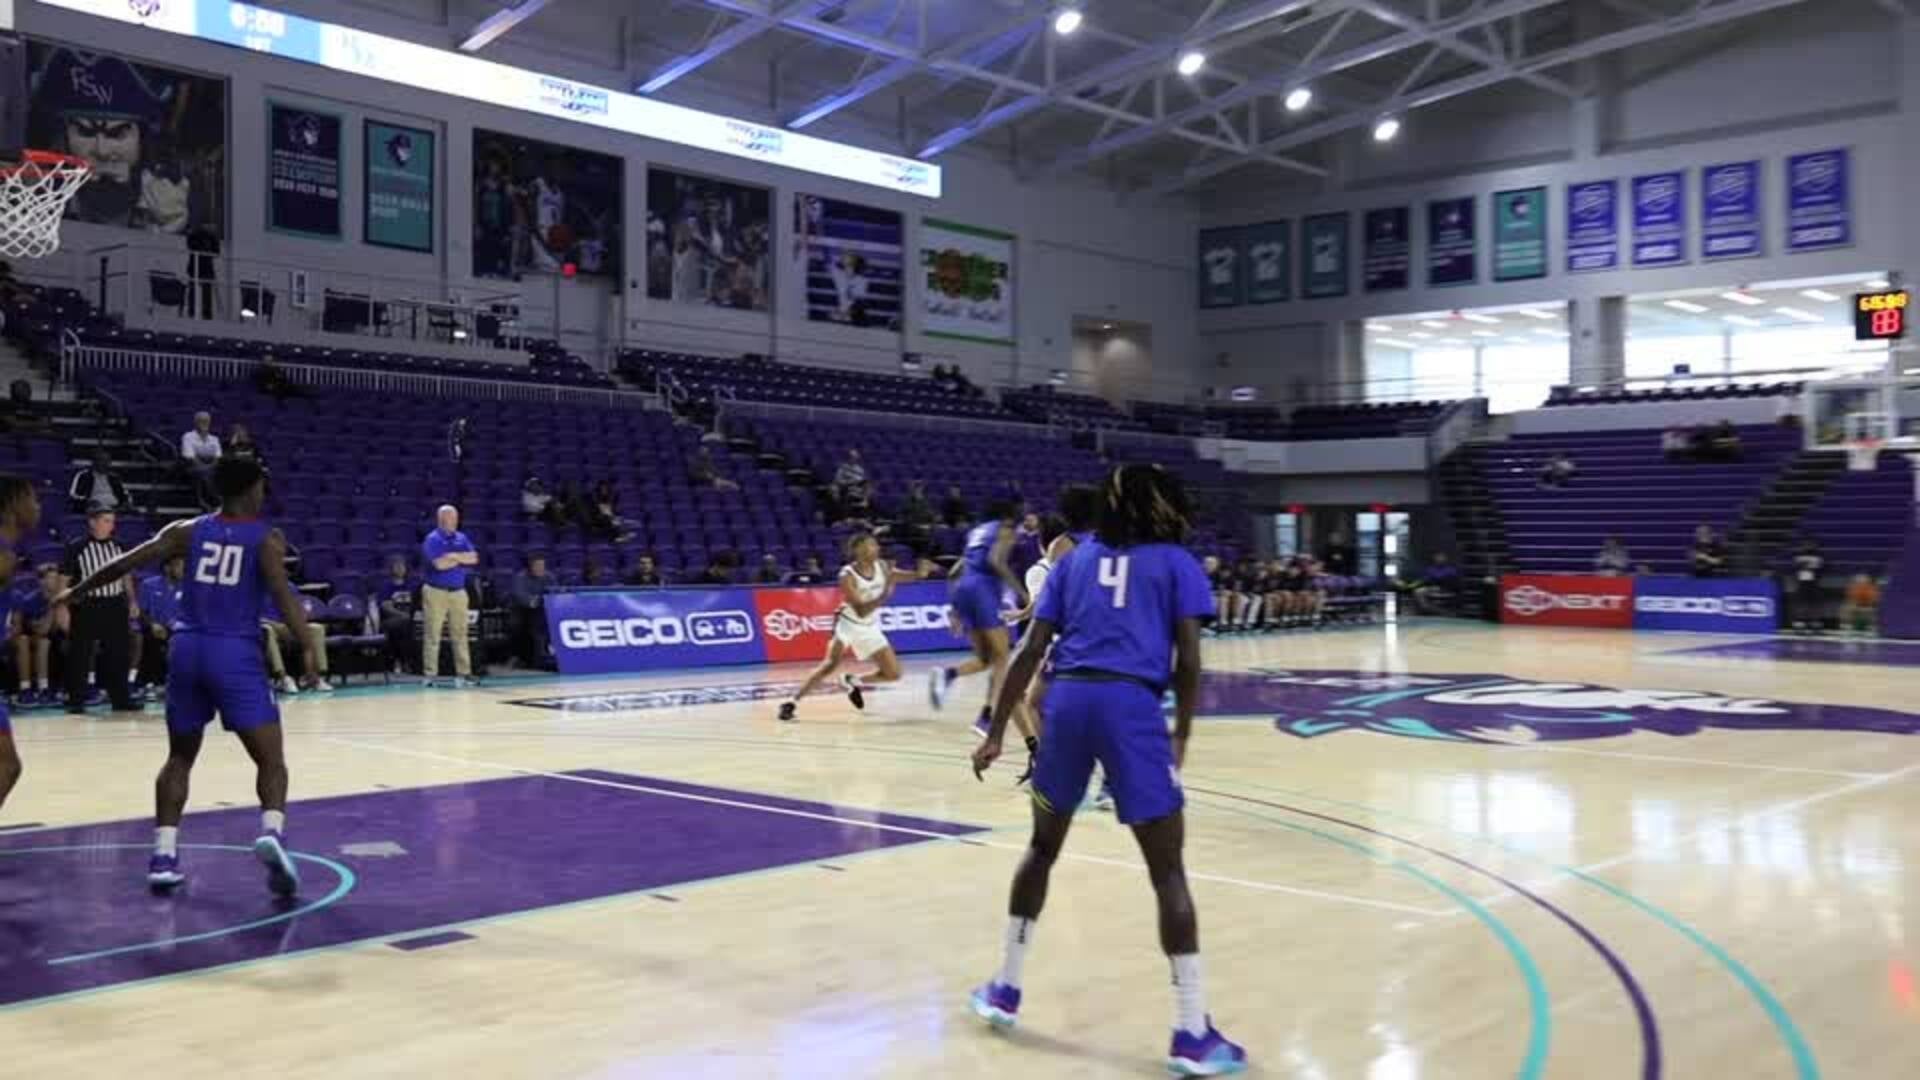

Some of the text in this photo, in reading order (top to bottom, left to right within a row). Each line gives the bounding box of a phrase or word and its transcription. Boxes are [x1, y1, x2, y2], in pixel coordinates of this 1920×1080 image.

[71, 66, 113, 114] FSW
[194, 541, 245, 586] 20
[1097, 555, 1131, 608] 4
[1634, 595, 1720, 614] GEICO
[559, 615, 684, 649] GEICO
